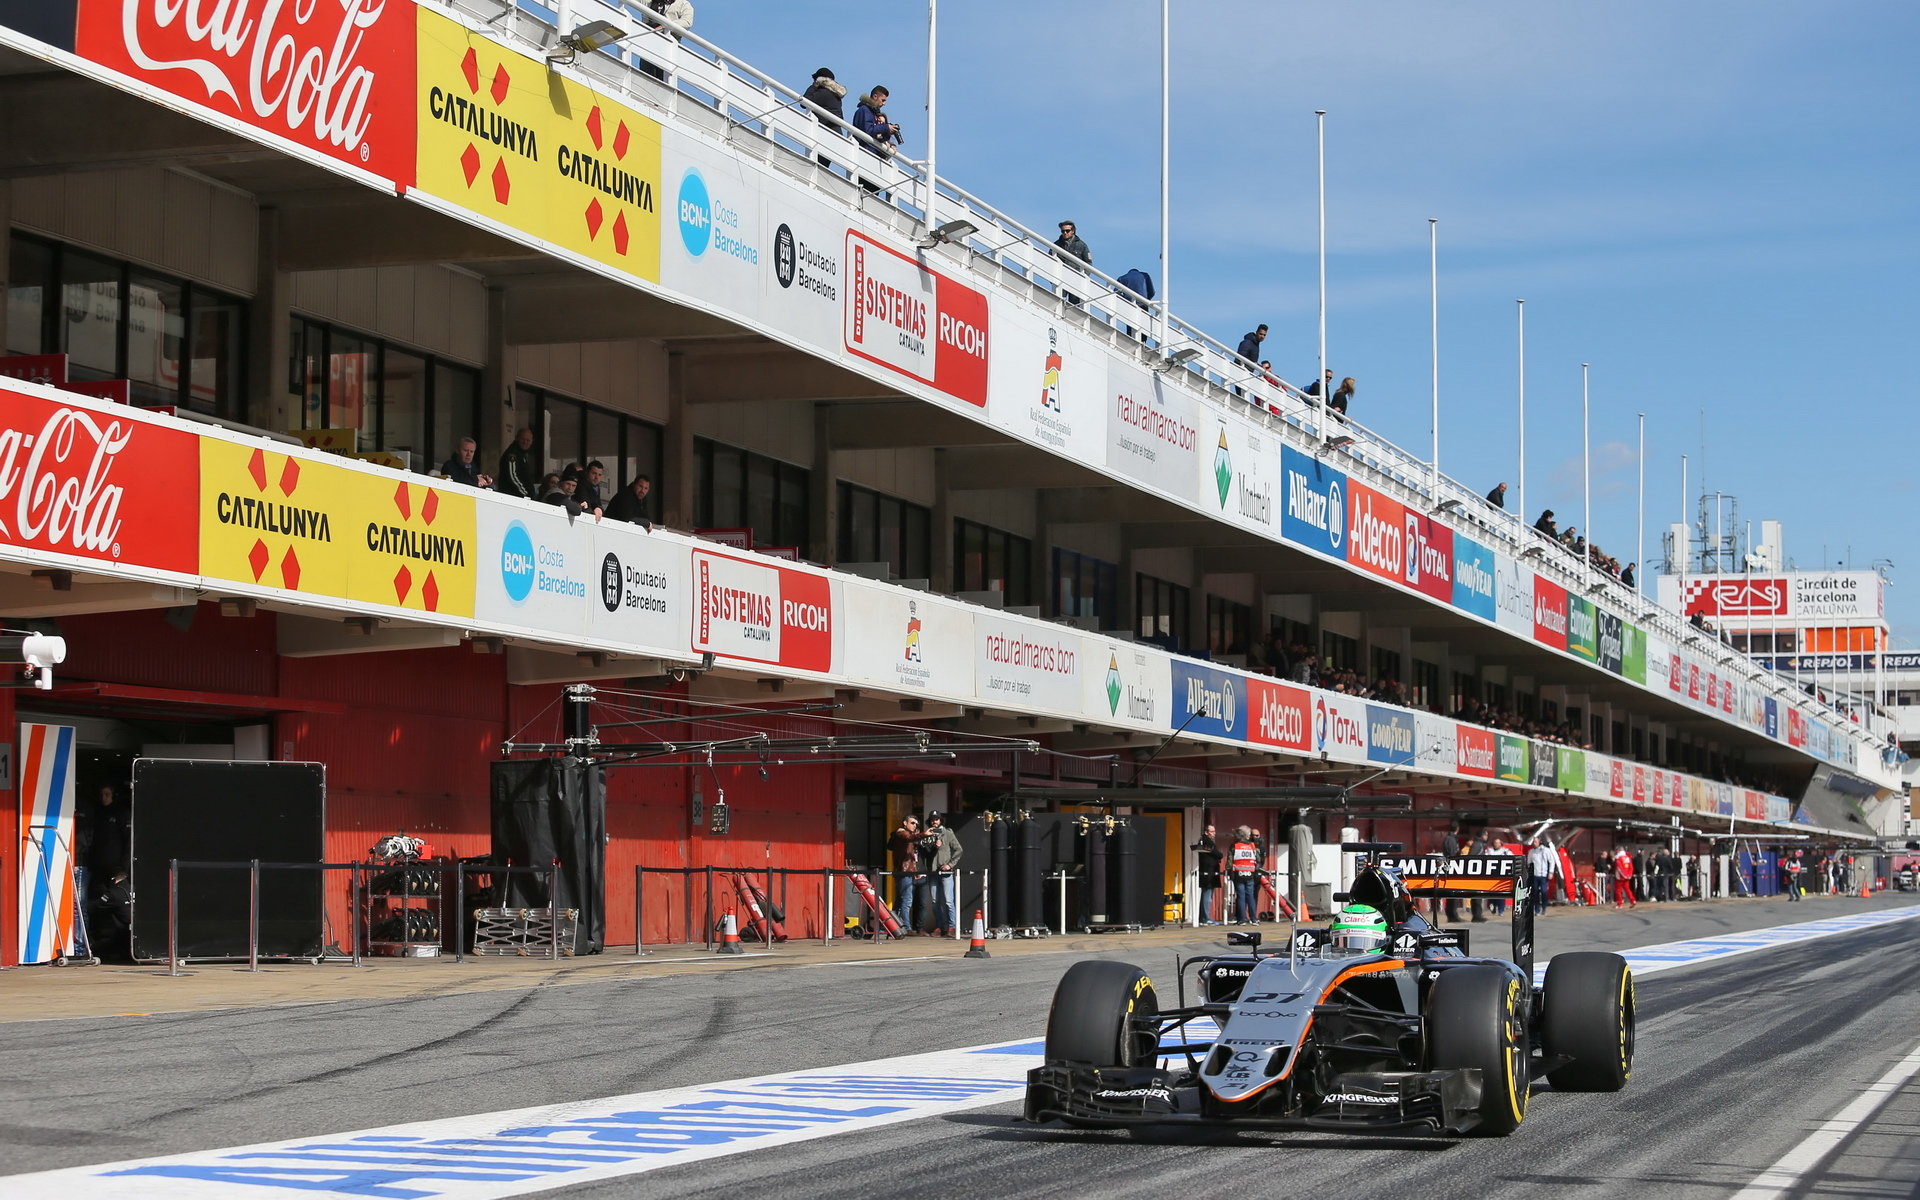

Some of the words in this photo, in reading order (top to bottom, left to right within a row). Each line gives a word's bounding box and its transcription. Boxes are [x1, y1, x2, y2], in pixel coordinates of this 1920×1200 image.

[430, 86, 539, 163] CATALUNYA
[557, 145, 654, 214] CATALUNYA
[714, 200, 738, 229] Costa
[714, 228, 758, 265] Barcelona
[799, 242, 837, 276] Diputació
[799, 268, 836, 301] Barcelona
[855, 252, 863, 337] DIGITALES
[866, 276, 927, 340] SISTEMAS
[898, 333, 925, 356] CATALUNYA
[940, 312, 986, 360] RICOH
[1117, 393, 1177, 444] naturalmarcs
[1180, 415, 1196, 453] bcn
[217, 492, 331, 543] CATALUNYA
[1288, 469, 1327, 530] Allianz
[367, 522, 465, 567] CATALUNYA
[1351, 492, 1401, 574] Adecco
[538, 544, 564, 569] Costa
[1420, 535, 1449, 581] TOTAL
[538, 573, 585, 598] Barcelona
[626, 565, 667, 591] Diputació
[1457, 557, 1492, 598] GOODYEAR
[1797, 577, 1838, 590] Circuit
[1841, 577, 1857, 590] de
[625, 590, 667, 614] Barcelona
[711, 585, 772, 629] SISTEMAS
[1797, 592, 1857, 603] Barcelona
[743, 626, 771, 642] CATALUNYA
[783, 599, 828, 633] RICOH
[1542, 596, 1567, 636] Santander
[1570, 598, 1593, 642] Europcar
[986, 633, 1055, 674] naturalmarcs
[1057, 641, 1075, 675] bcn
[1803, 657, 1853, 668] REPSOL
[1003, 680, 1012, 694] por
[1012, 679, 1016, 692] el
[1016, 679, 1031, 696] trabajo
[1186, 677, 1222, 720] Allianz
[1260, 689, 1303, 744] Adecco
[1330, 708, 1363, 748] TOTAL
[1371, 716, 1412, 758] GOODYEAR
[1466, 736, 1493, 771] Santander
[1501, 736, 1523, 770] Europcar
[1344, 916, 1366, 924] Claro
[1244, 992, 1305, 1004] 27
[1223, 1038, 1285, 1046] PIRELLI
[1096, 1088, 1171, 1103] KINGFISHER
[1322, 1093, 1400, 1105] KINGFISHER
